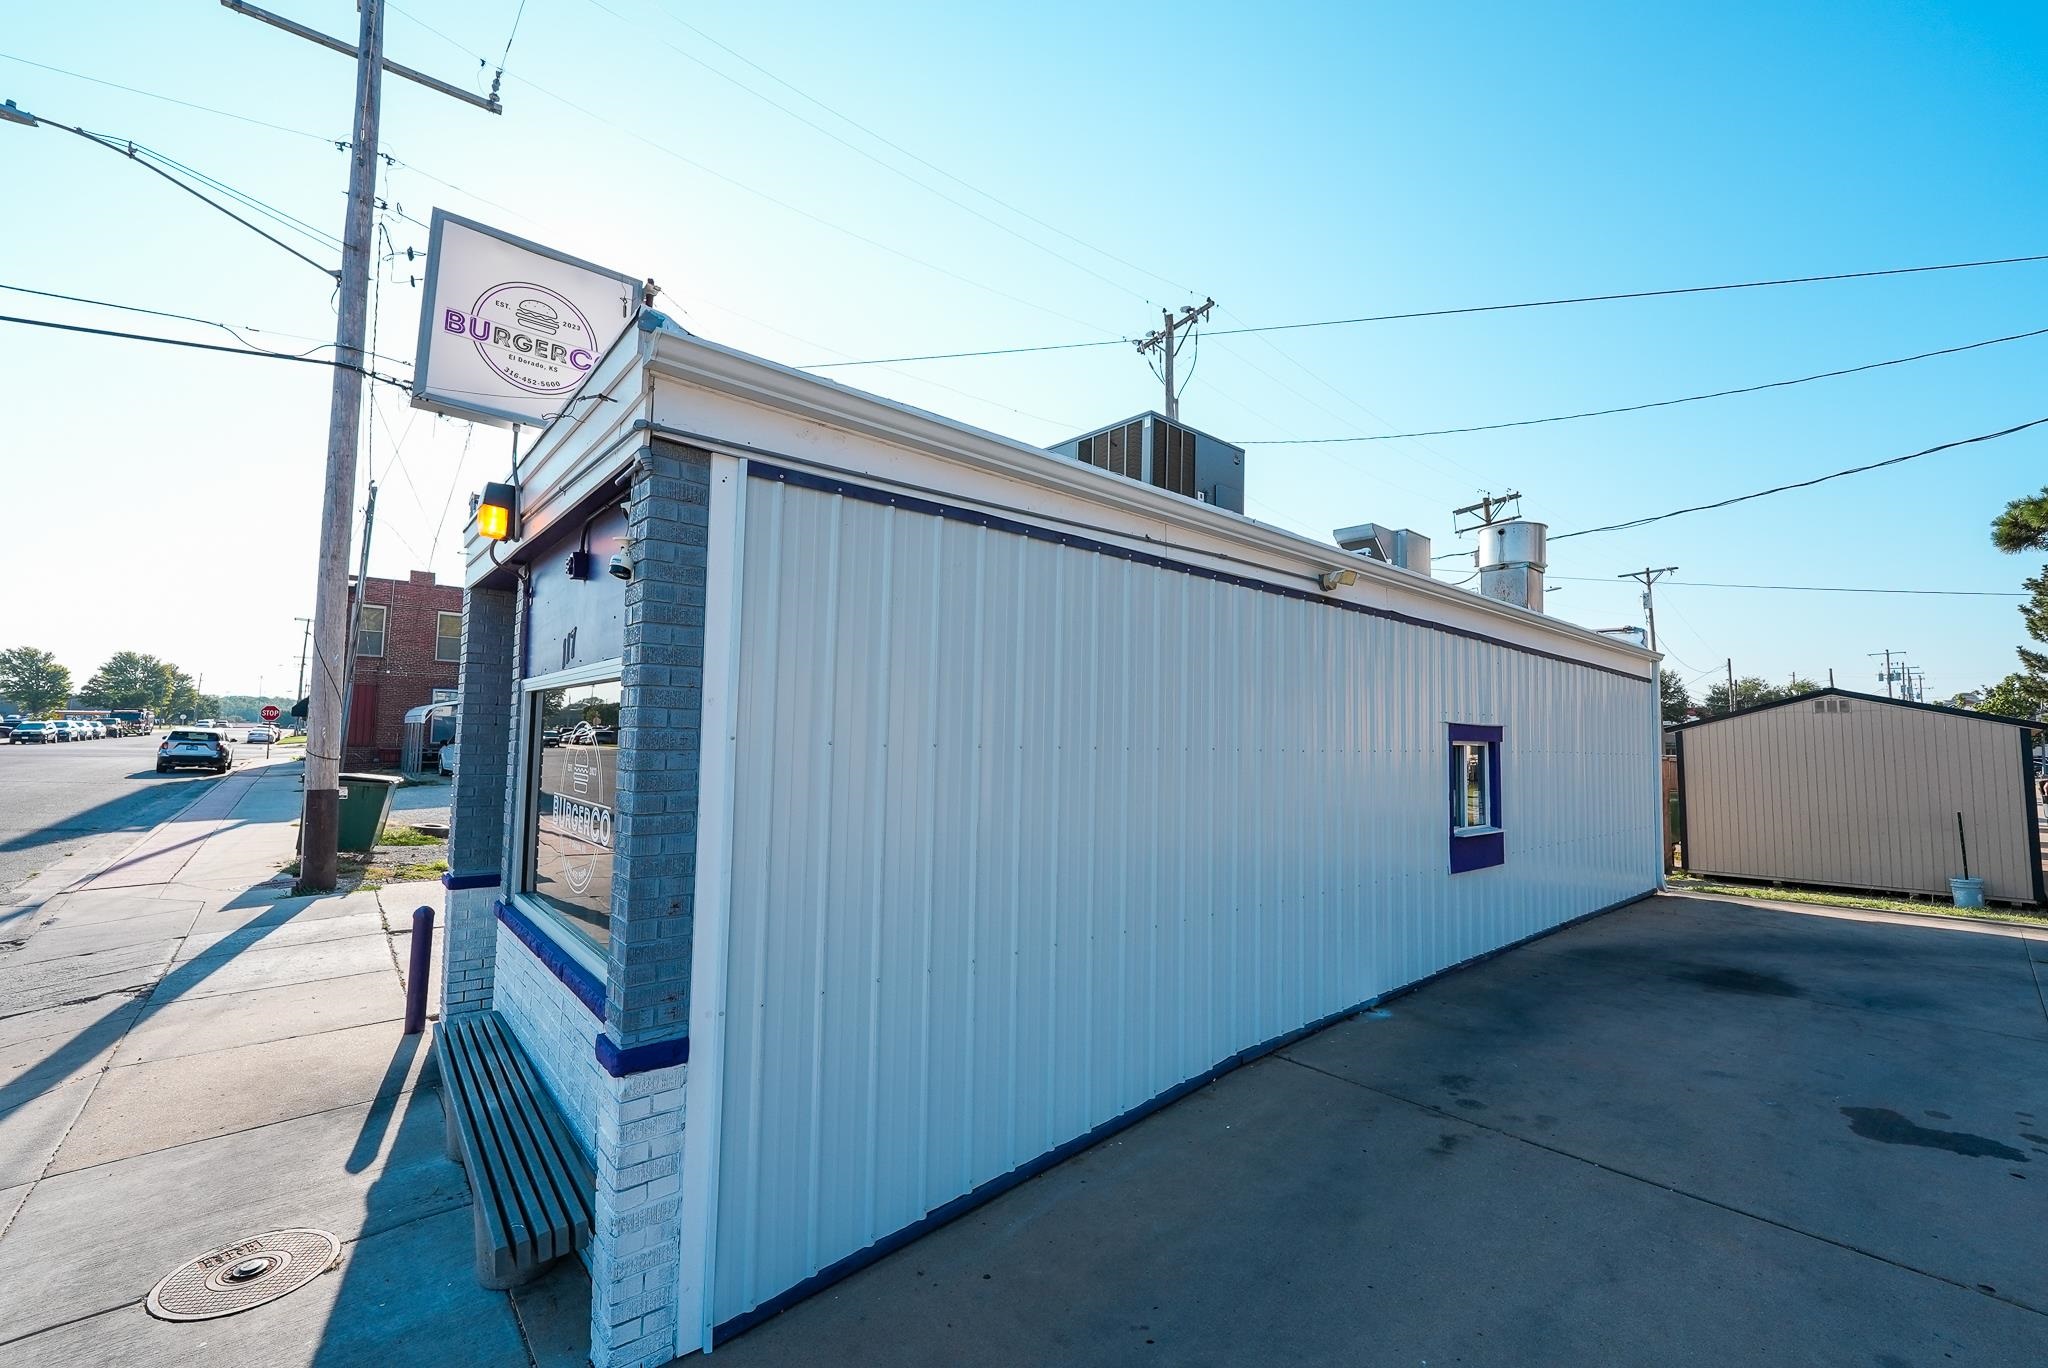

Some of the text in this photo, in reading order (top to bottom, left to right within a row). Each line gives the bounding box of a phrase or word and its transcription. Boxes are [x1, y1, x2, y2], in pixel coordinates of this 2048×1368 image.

[495, 300, 511, 310] EST.
[562, 321, 581, 331] 2023
[444, 308, 600, 371] BURGERC
[518, 357, 546, 370] Dorado,
[549, 365, 558, 373] KS
[503, 367, 561, 388] 316-452-5600
[261, 709, 279, 717] STOP
[552, 795, 611, 846] BURGERCO
